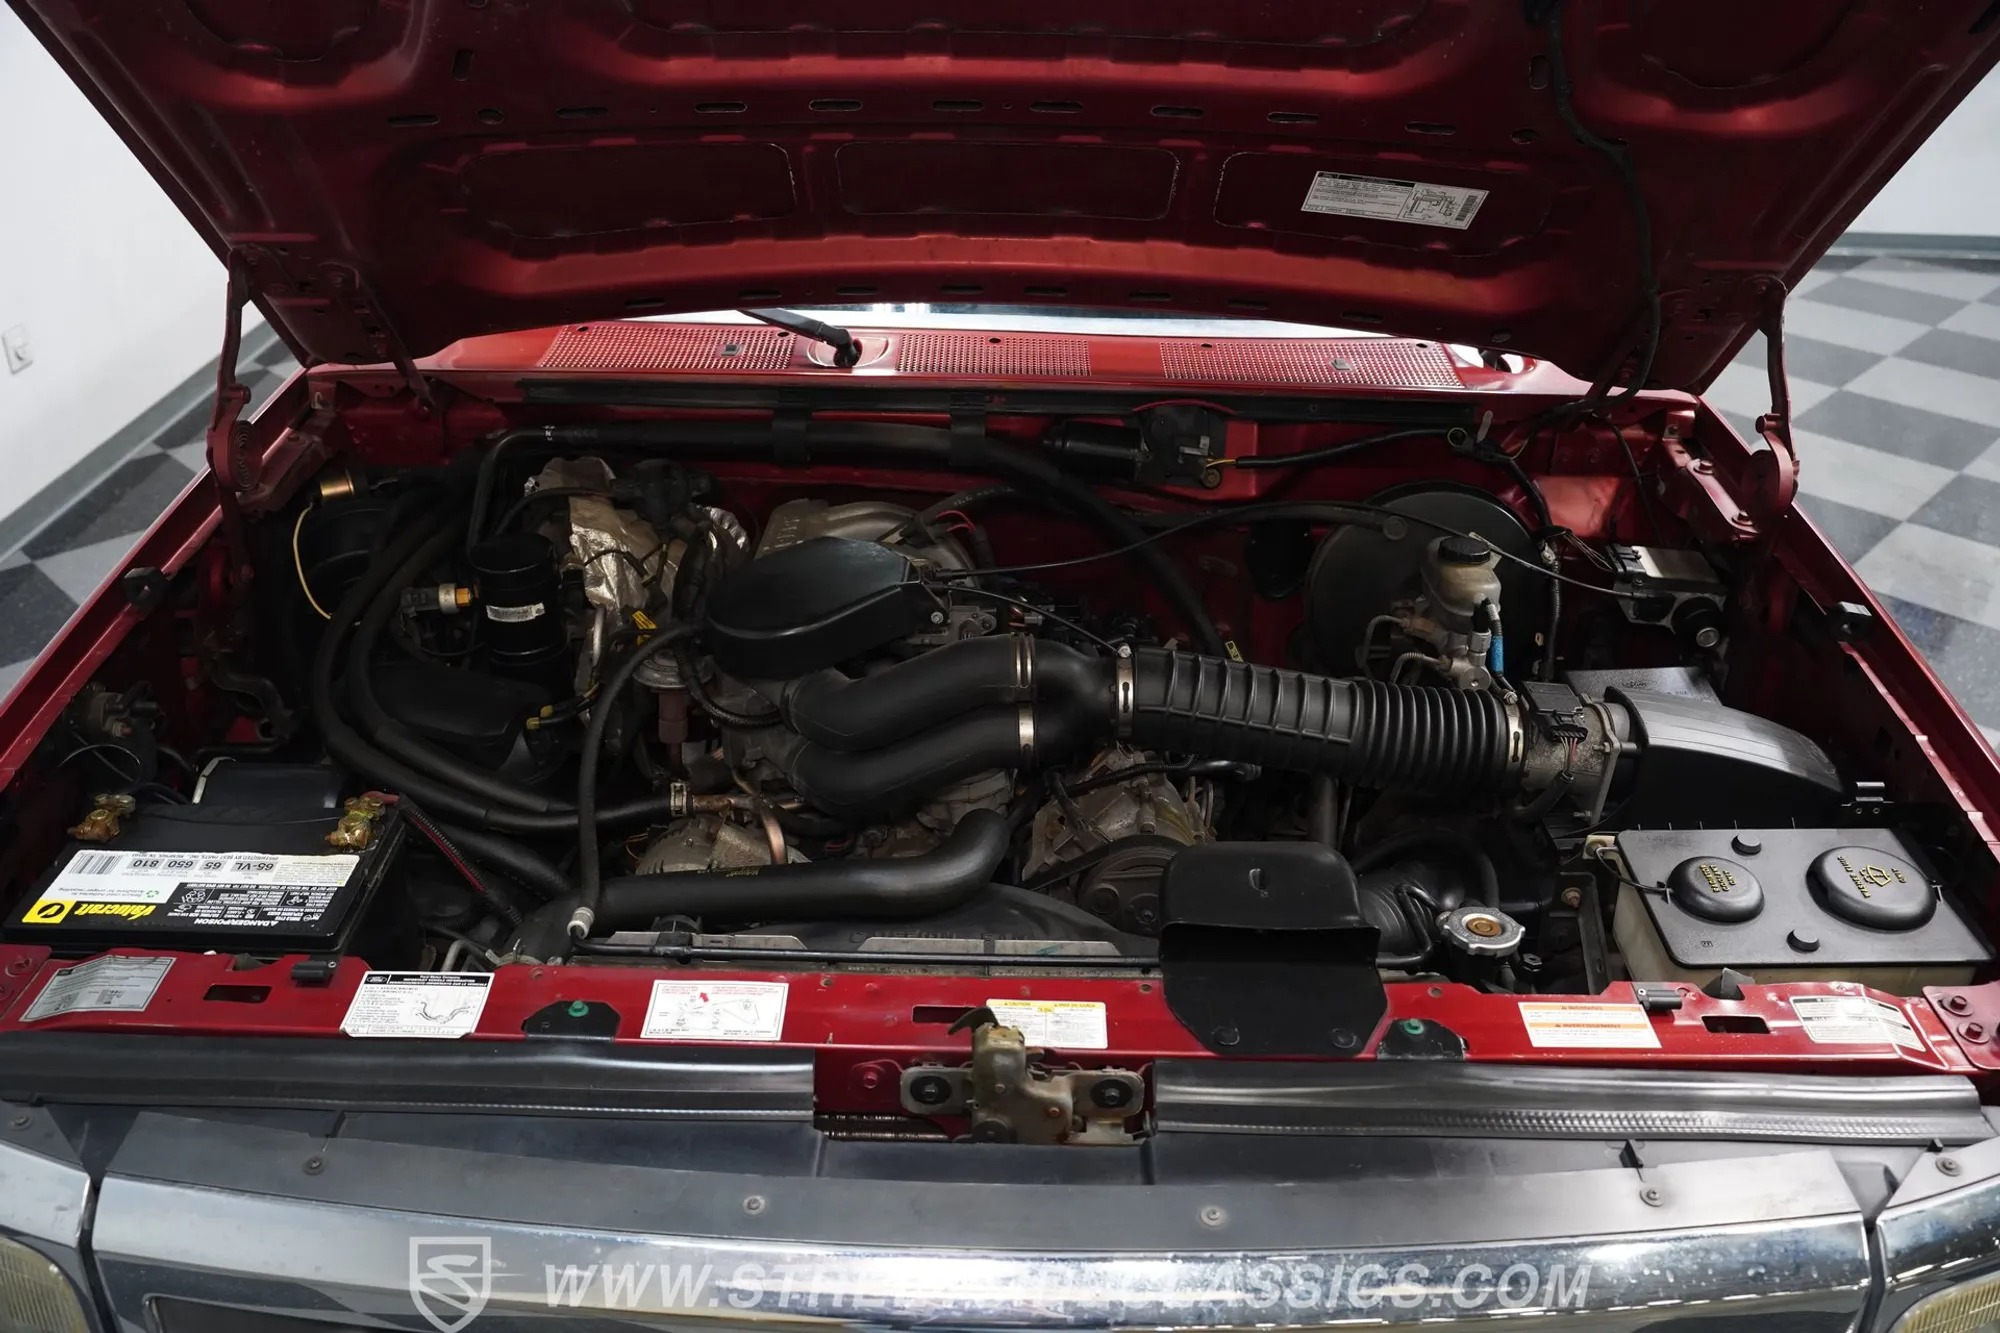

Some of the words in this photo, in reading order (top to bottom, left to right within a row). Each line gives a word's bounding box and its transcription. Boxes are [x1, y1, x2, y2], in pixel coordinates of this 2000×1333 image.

[133, 860, 159, 868] 810
[168, 860, 193, 868] 650
[205, 862, 222, 870] 65
[235, 862, 274, 871] 65-VL
[74, 904, 156, 920] Valucraft
[194, 918, 271, 926] DANGER/POISON
